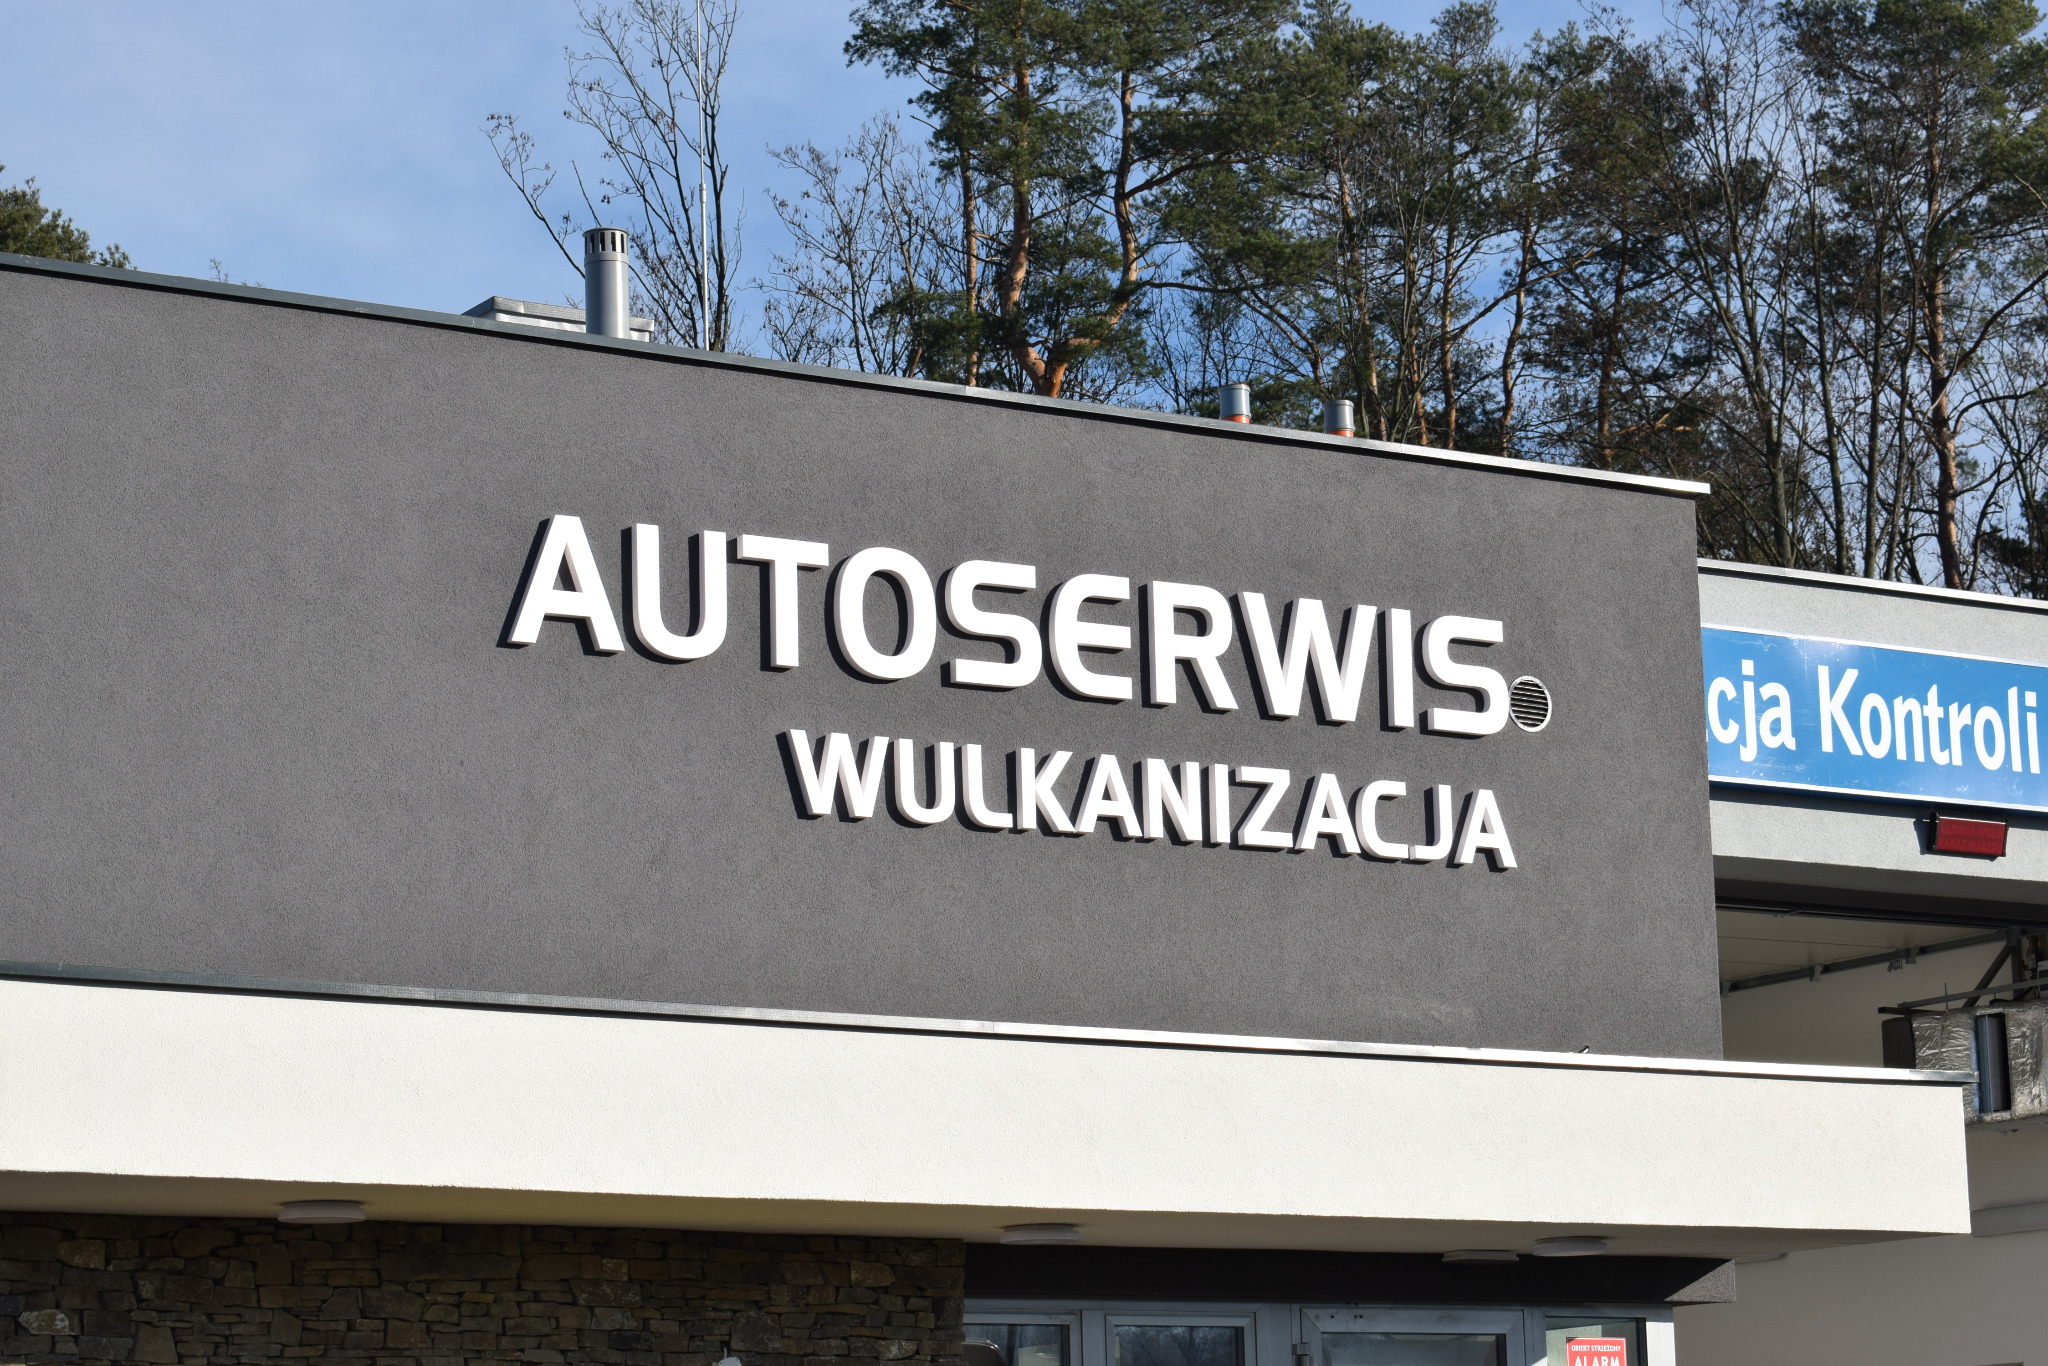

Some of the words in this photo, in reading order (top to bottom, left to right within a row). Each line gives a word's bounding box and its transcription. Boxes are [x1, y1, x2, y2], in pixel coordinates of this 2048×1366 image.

[507, 514, 1511, 738] AUTOSERWIS
[1706, 658, 1797, 763] cja
[1817, 664, 2041, 775] Kontroli
[786, 728, 1519, 869] WULKANIZACJA
